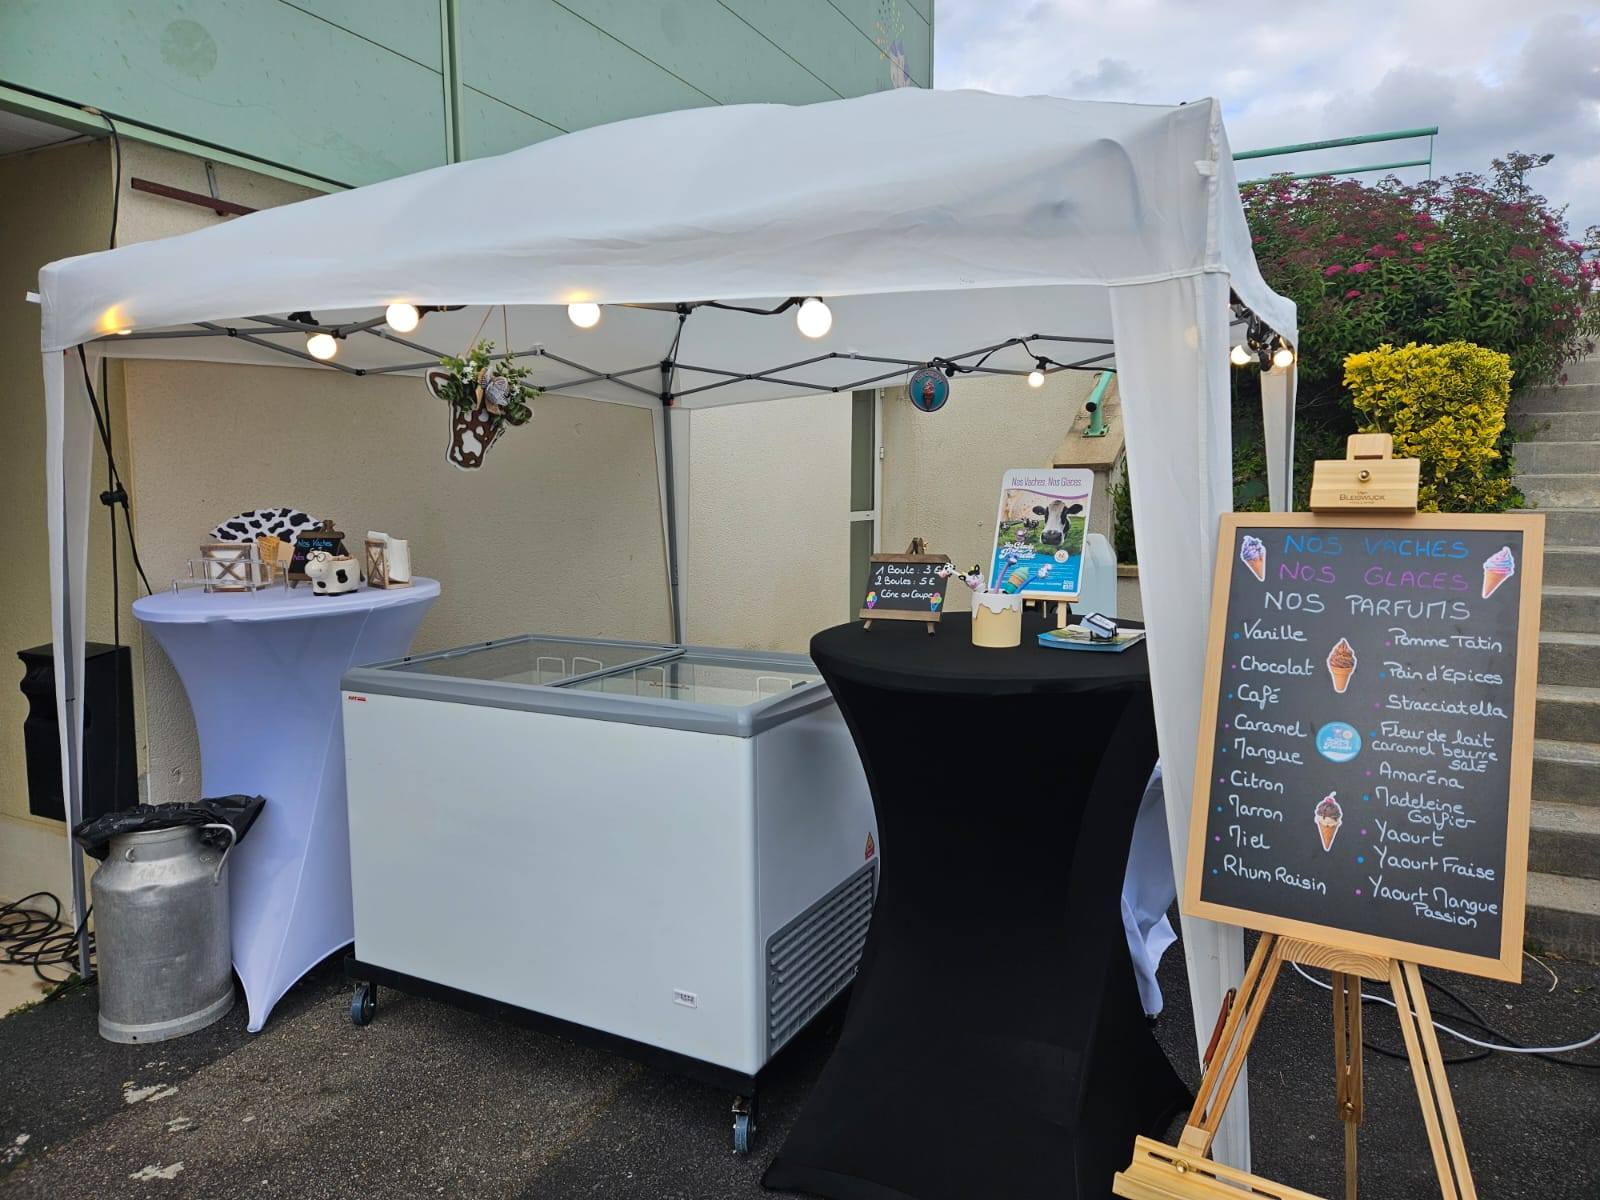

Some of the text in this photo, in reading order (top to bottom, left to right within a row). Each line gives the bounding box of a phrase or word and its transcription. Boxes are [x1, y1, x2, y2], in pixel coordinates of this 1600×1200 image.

[1284, 534, 1469, 559] NOS VACHES
[875, 565, 884, 575] 1
[887, 564, 915, 575] Boule
[875, 575, 882, 586] 2
[884, 575, 912, 586] Boules
[1279, 561, 1469, 592] NOS GLACES
[901, 591, 911, 599] ou
[911, 589, 934, 600] Coupe
[1264, 591, 1471, 620] NOS PARFUMS
[1243, 618, 1308, 641] Vanille
[1388, 627, 1503, 653] Pomme Tatin
[1240, 655, 1315, 675] Chocolat
[1383, 661, 1423, 680] Pain
[1237, 683, 1281, 710] Café
[1385, 694, 1508, 719] Stracciatella
[1234, 713, 1308, 737] Caramel
[1380, 721, 1496, 748] Fleur de lait
[1234, 737, 1304, 765] Mangue
[1371, 740, 1436, 756] caramel
[1441, 743, 1499, 761] beurre
[1448, 759, 1489, 773] salé
[1230, 769, 1284, 795] Citron
[1228, 794, 1283, 822] Marron
[1375, 786, 1465, 815] Madeleine
[1374, 818, 1445, 847] Yaourt
[1407, 809, 1477, 831] Golfier
[1229, 825, 1271, 849] Miel
[1223, 854, 1327, 896] Rhum Raisin
[1373, 844, 1495, 881] Yaourt Fraise
[1368, 874, 1498, 915] Yaourt Mangue
[1412, 901, 1478, 928] Passion
